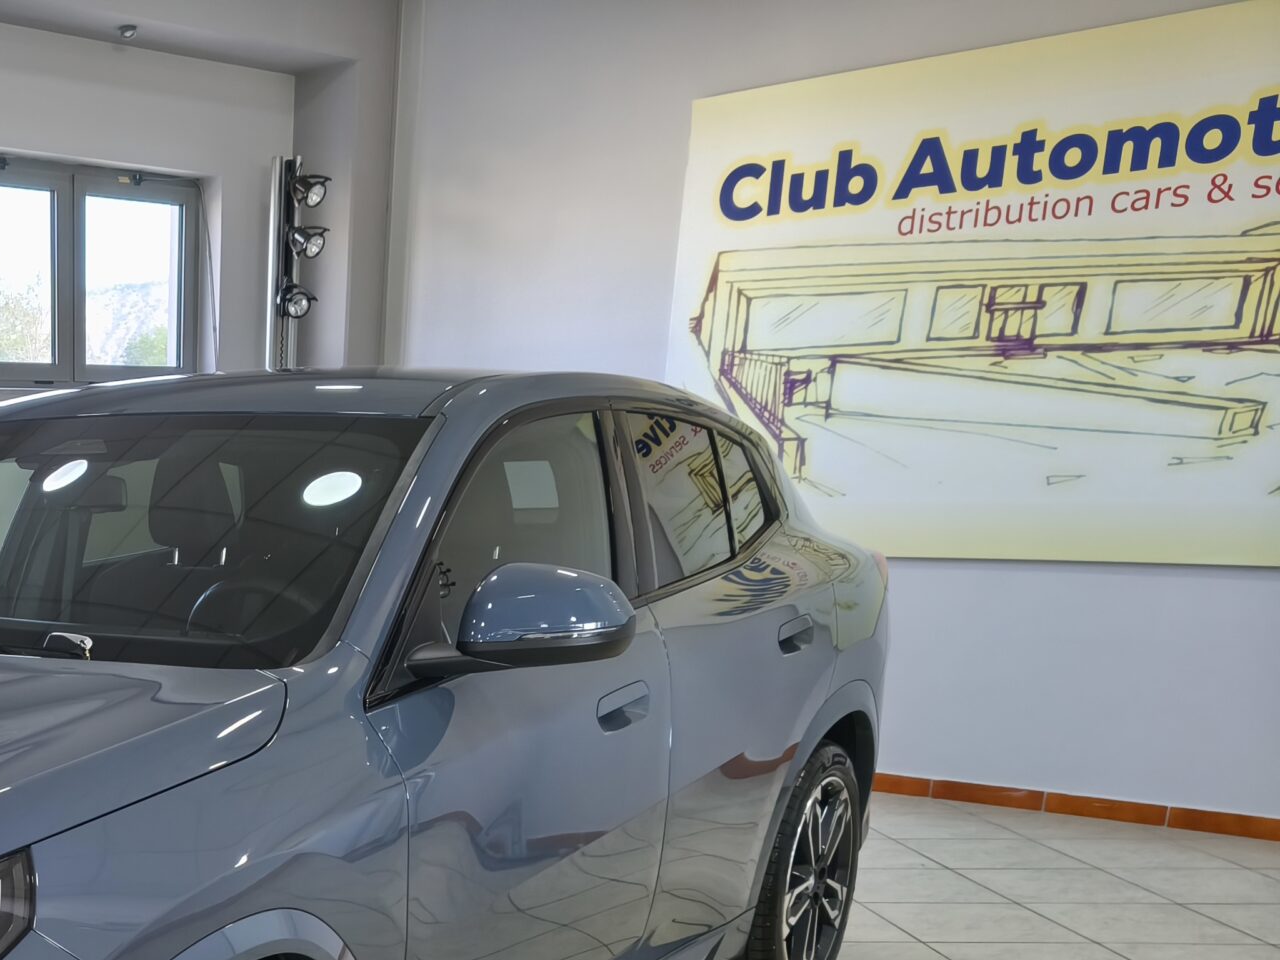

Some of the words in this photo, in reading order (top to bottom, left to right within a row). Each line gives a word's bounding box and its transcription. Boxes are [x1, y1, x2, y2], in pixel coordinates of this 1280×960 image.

[719, 149, 879, 221] Club
[892, 94, 1280, 200] Automot
[897, 193, 1094, 236] distribution
[1110, 183, 1191, 213] cars
[1206, 173, 1235, 203] &
[1251, 175, 1280, 198] s
